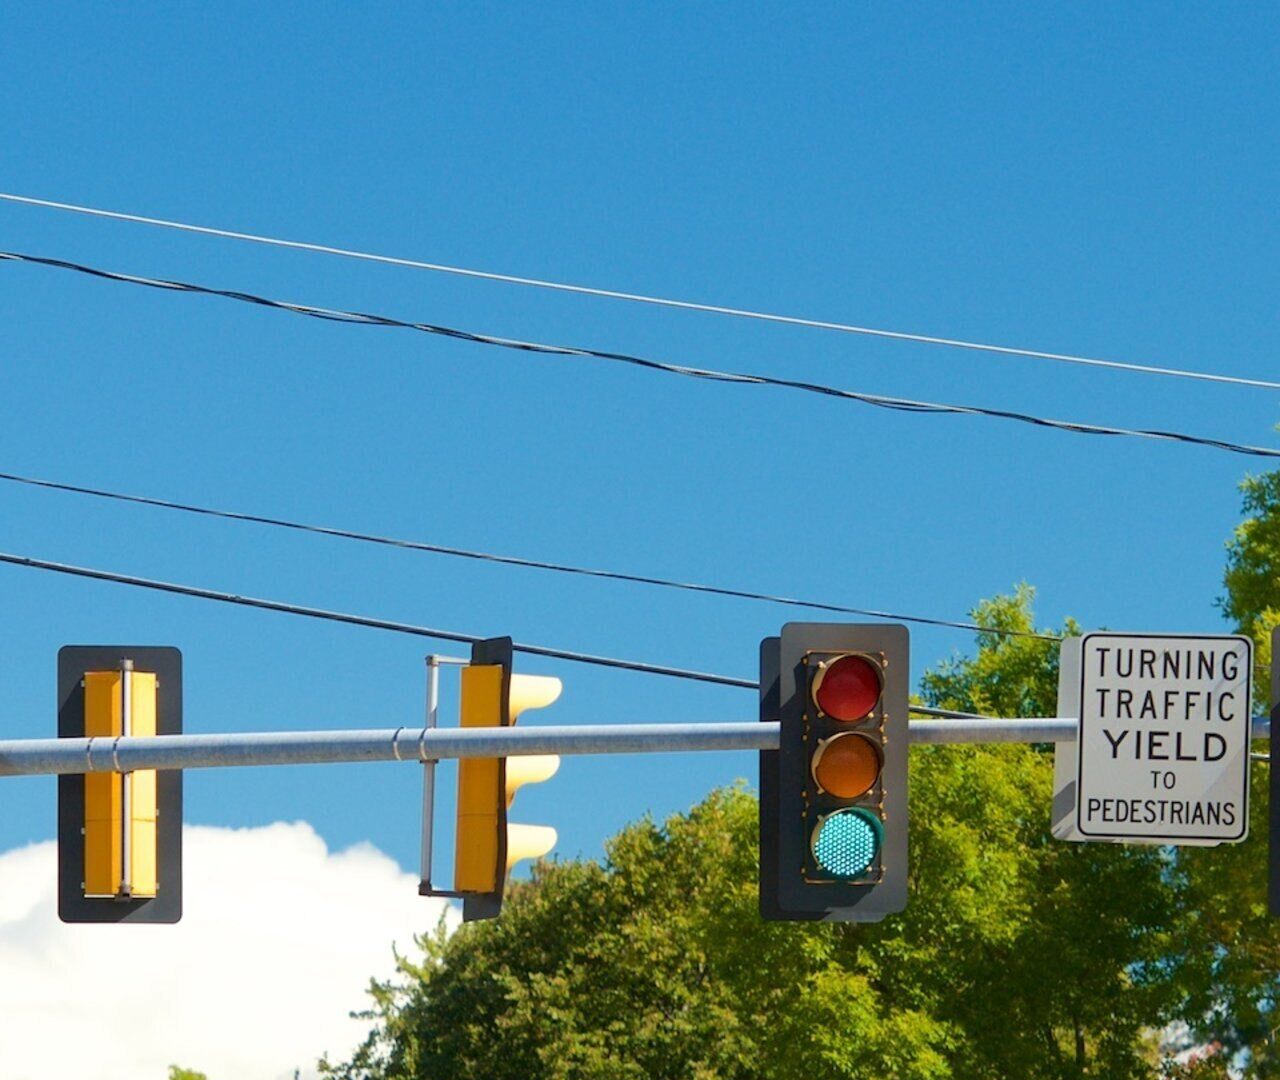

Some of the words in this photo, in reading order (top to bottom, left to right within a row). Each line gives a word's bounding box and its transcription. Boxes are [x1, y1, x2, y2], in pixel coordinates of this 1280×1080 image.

[1096, 648, 1239, 681] TURNING
[1096, 688, 1236, 722] TRAFFIC
[1102, 729, 1228, 763] YIELD
[1150, 770, 1176, 790] TO
[1088, 798, 1236, 827] PEDESTRIANS
